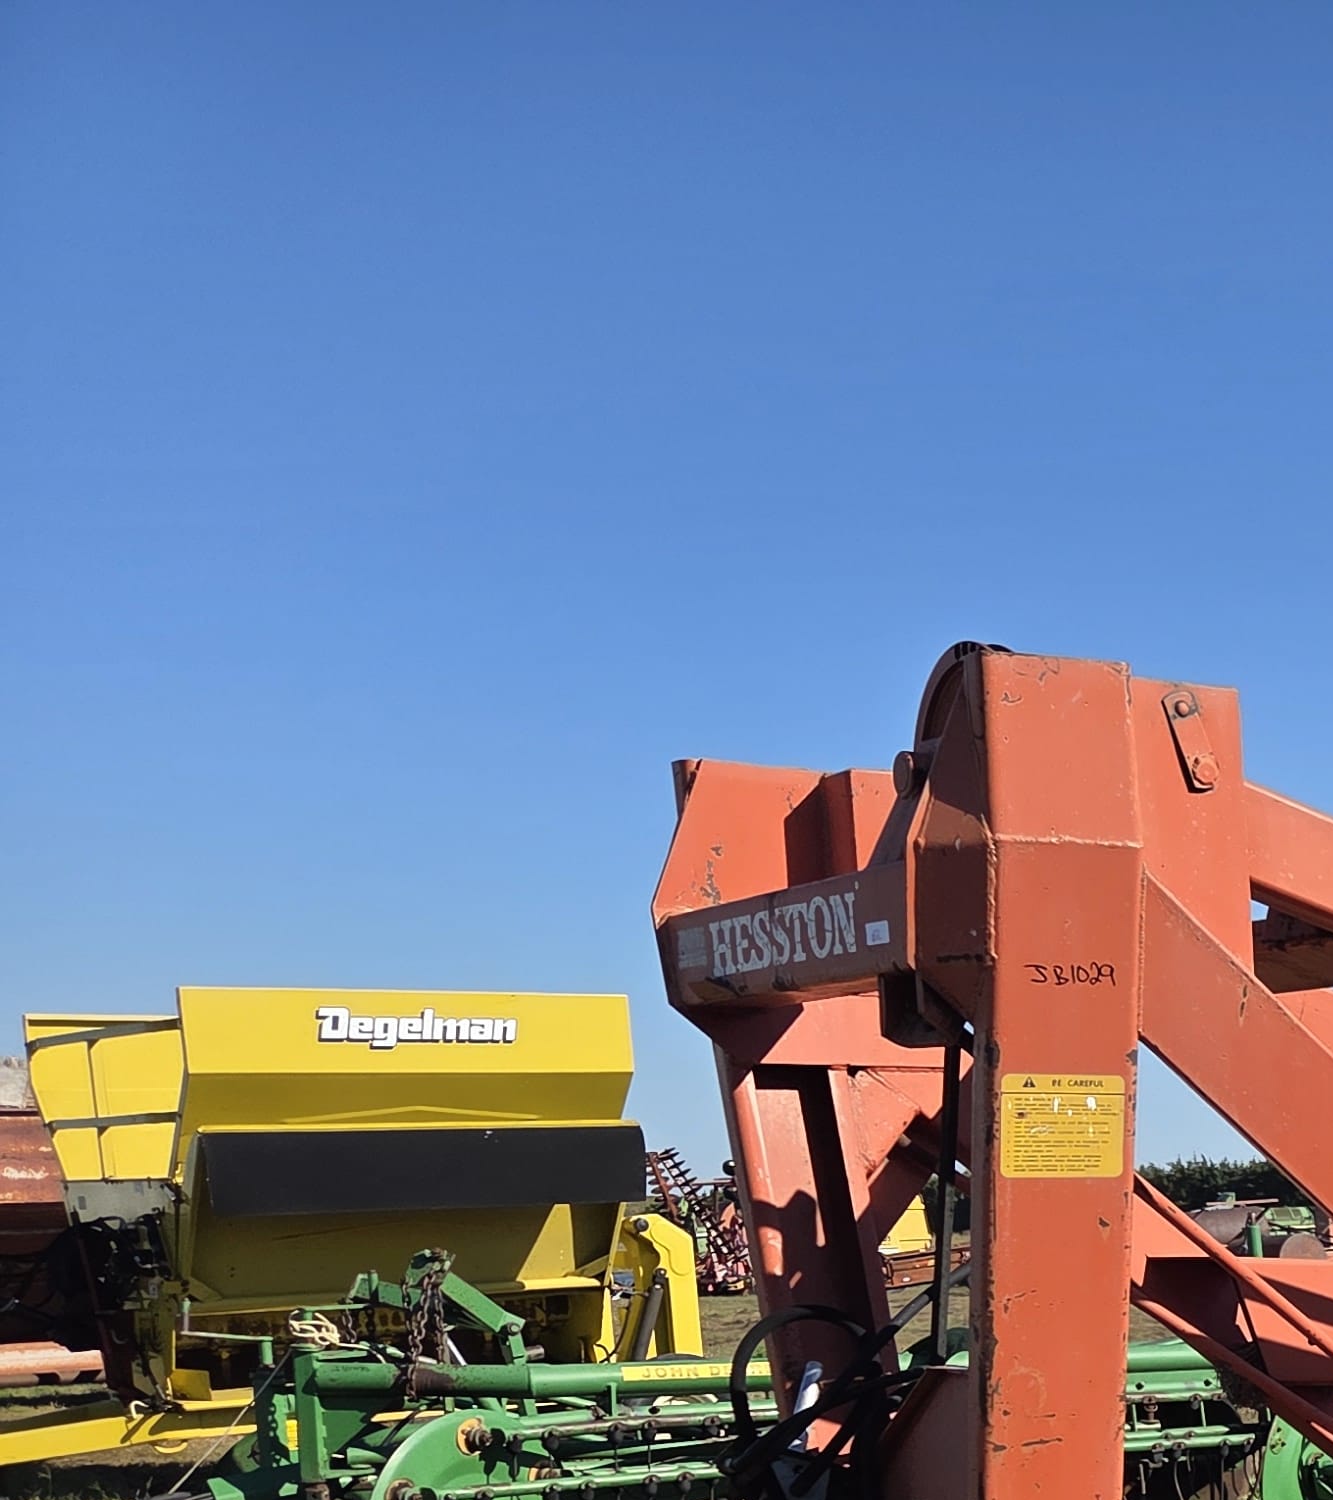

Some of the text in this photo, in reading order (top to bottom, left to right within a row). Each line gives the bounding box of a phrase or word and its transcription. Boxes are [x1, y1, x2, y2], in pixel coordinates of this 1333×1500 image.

[708, 891, 857, 978] HESSTON
[315, 1006, 518, 1050] Degelman
[1067, 1079, 1104, 1088] CAREFUL
[641, 1366, 699, 1379] JOHN
